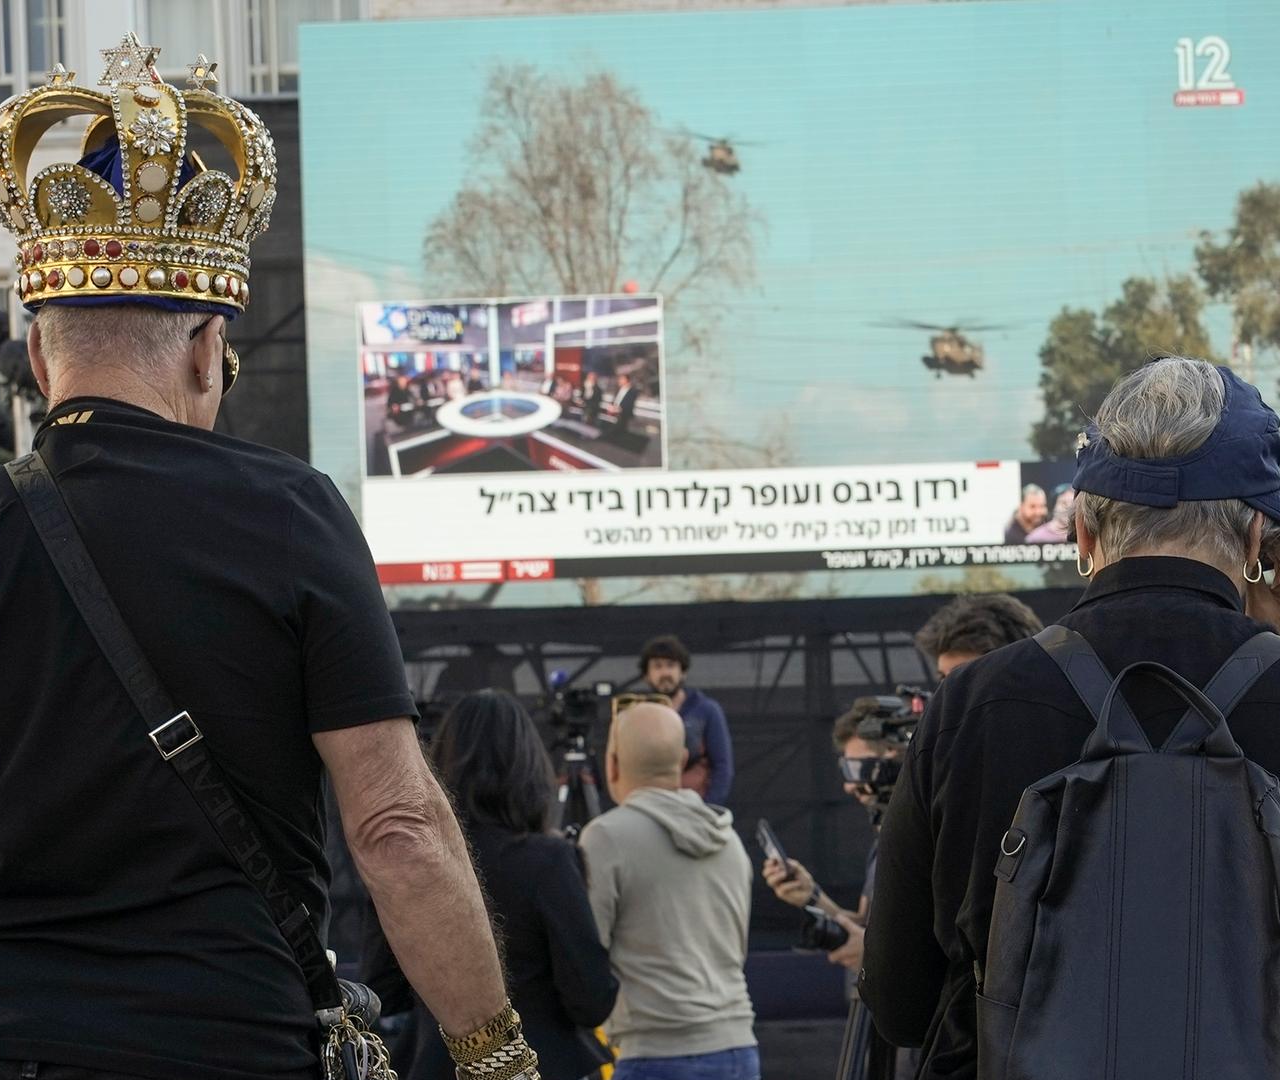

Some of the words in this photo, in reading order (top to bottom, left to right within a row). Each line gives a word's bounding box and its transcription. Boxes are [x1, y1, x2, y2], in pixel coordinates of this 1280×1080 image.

[1173, 36, 1233, 89] 12
[569, 489, 624, 511] בידי
[635, 481, 731, 517] קלדרון
[742, 483, 821, 508] ועופר
[832, 481, 903, 504] ביבס
[915, 477, 968, 509] ירדן
[585, 526, 652, 545] מהשבי
[888, 518, 917, 539] זמן
[925, 515, 970, 533] בעוד
